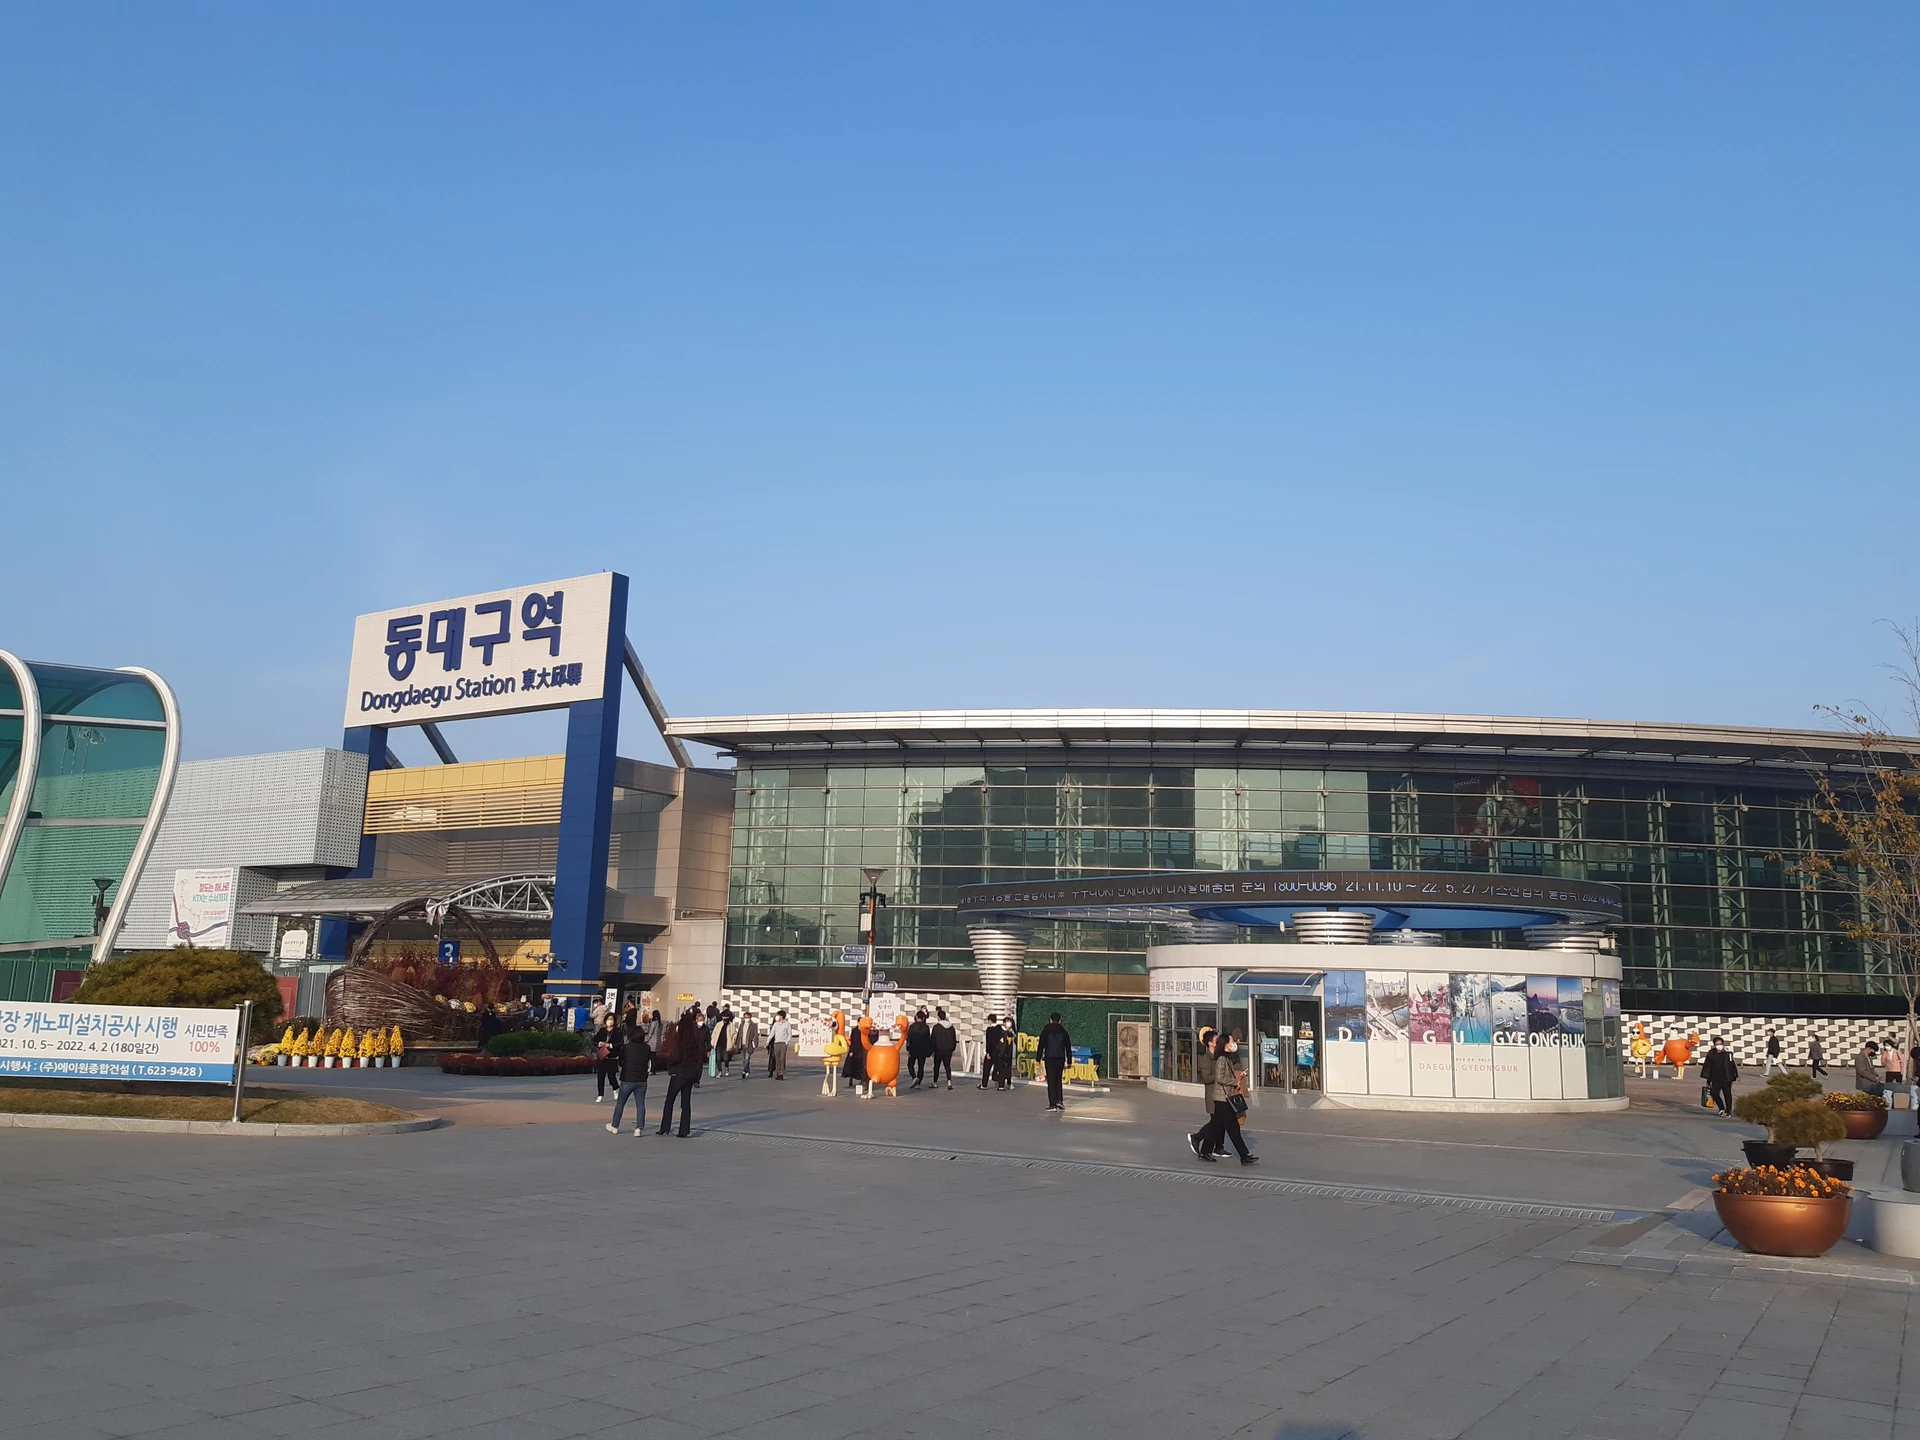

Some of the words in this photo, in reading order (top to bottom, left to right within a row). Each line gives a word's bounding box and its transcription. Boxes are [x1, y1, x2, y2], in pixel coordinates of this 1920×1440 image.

[384, 590, 564, 681] 동대구역
[520, 662, 583, 691] 東大邱驛
[360, 684, 452, 713] Dongdaegu
[454, 673, 516, 700] Station
[624, 946, 638, 971] 3
[1175, 980, 1208, 992] 참여합시다!
[874, 1010, 895, 1021] 치맥
[23, 1011, 141, 1038] 캐노피설치공사
[144, 1016, 179, 1039] 시행
[184, 1024, 229, 1039] 시민만족
[802, 1027, 820, 1036] 힘내라
[0, 1038, 18, 1050] 21.
[56, 1041, 86, 1052] 2022.
[110, 1042, 159, 1055] (180일간)
[188, 1041, 221, 1053] 100%
[800, 1036, 830, 1046] 가을이다
[1493, 1030, 1585, 1049] GYEONGBUK
[0, 1060, 31, 1072] 시행사
[39, 1061, 129, 1076] (주)에이원종합건설
[1461, 1063, 1519, 1072] GYEONGBUK
